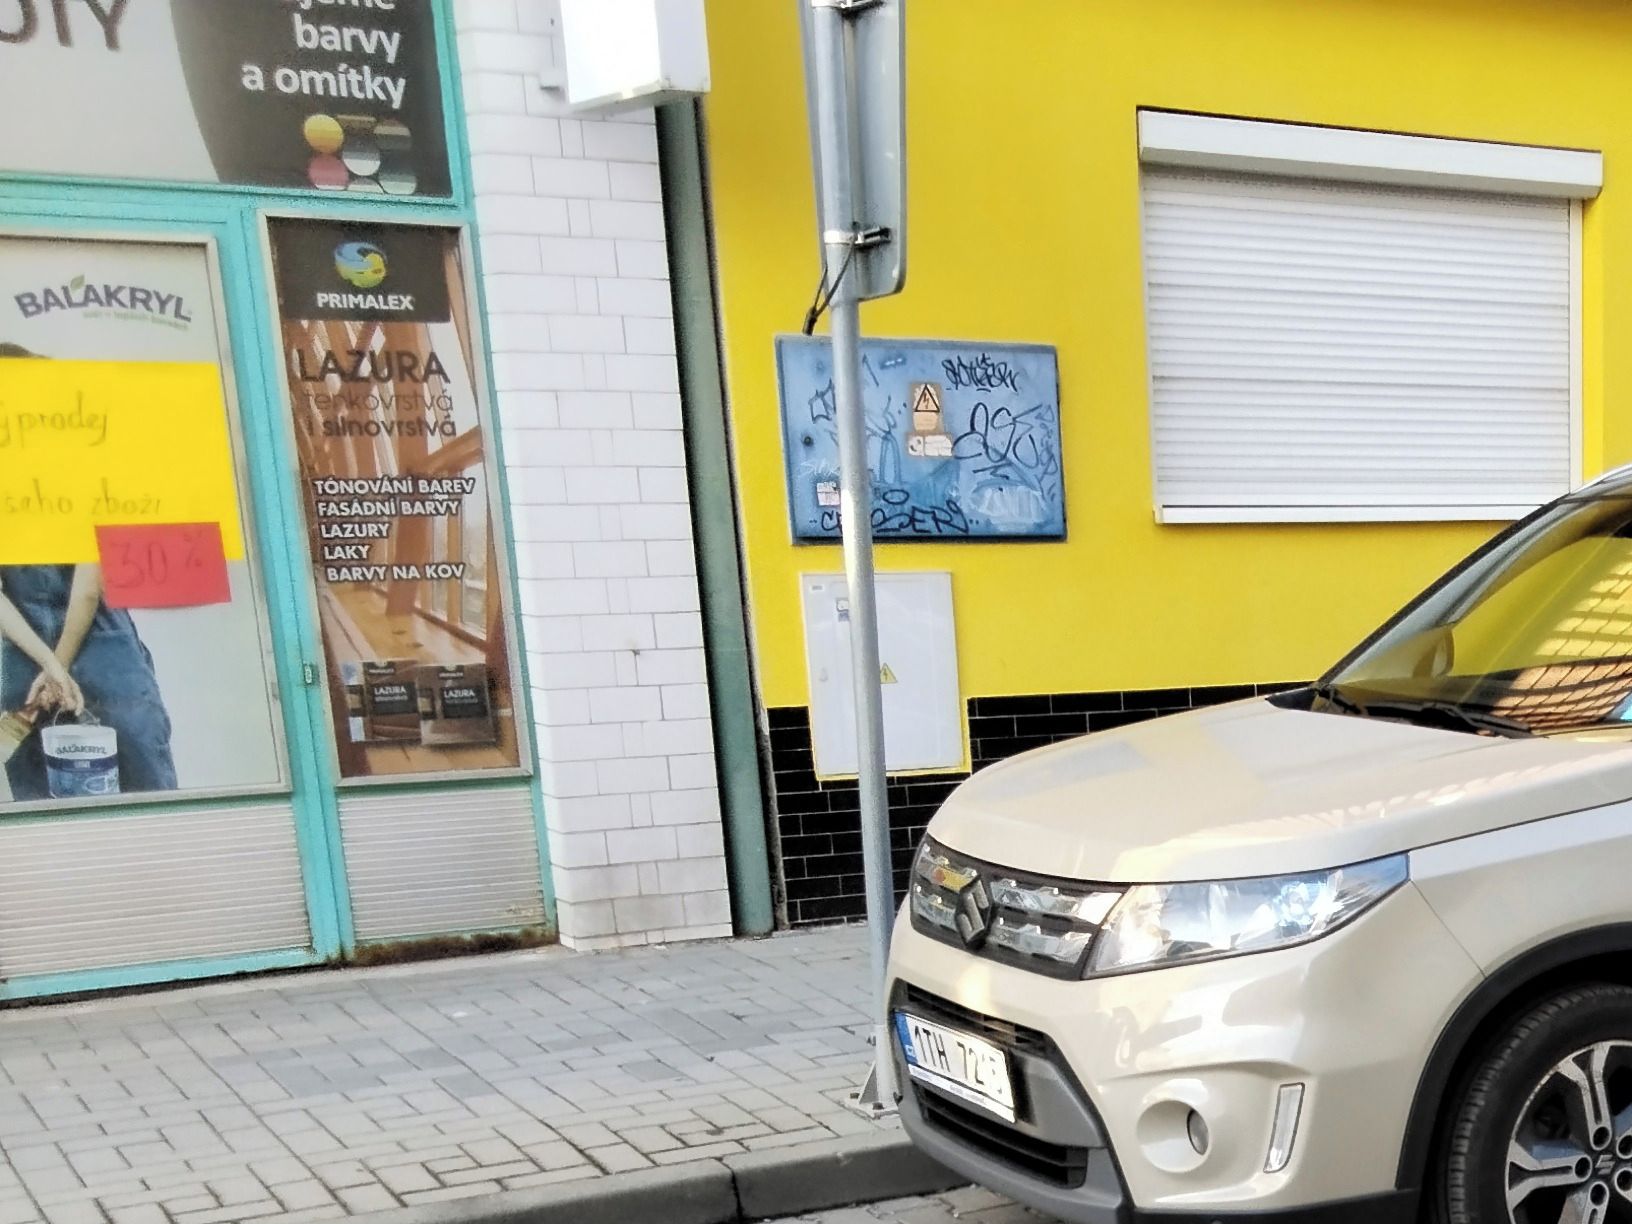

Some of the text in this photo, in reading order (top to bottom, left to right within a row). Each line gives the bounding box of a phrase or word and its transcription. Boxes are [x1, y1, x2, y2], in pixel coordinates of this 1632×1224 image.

[293, 13, 401, 64] barvy
[241, 63, 407, 109] a omítky
[316, 292, 415, 311] PRIMALEX
[300, 350, 451, 384] LAZURA
[322, 412, 457, 437] silnovrstvá
[314, 474, 476, 495] TÓNOVÁNÍ BAREV
[317, 498, 460, 516] FASÁDNÍ BARVY
[320, 523, 390, 538] LAZURY
[323, 545, 370, 560] LAKY
[327, 564, 465, 582] BARVY NA KOV
[443, 689, 476, 698] LAZURA
[914, 1025, 951, 1073] 1TH
